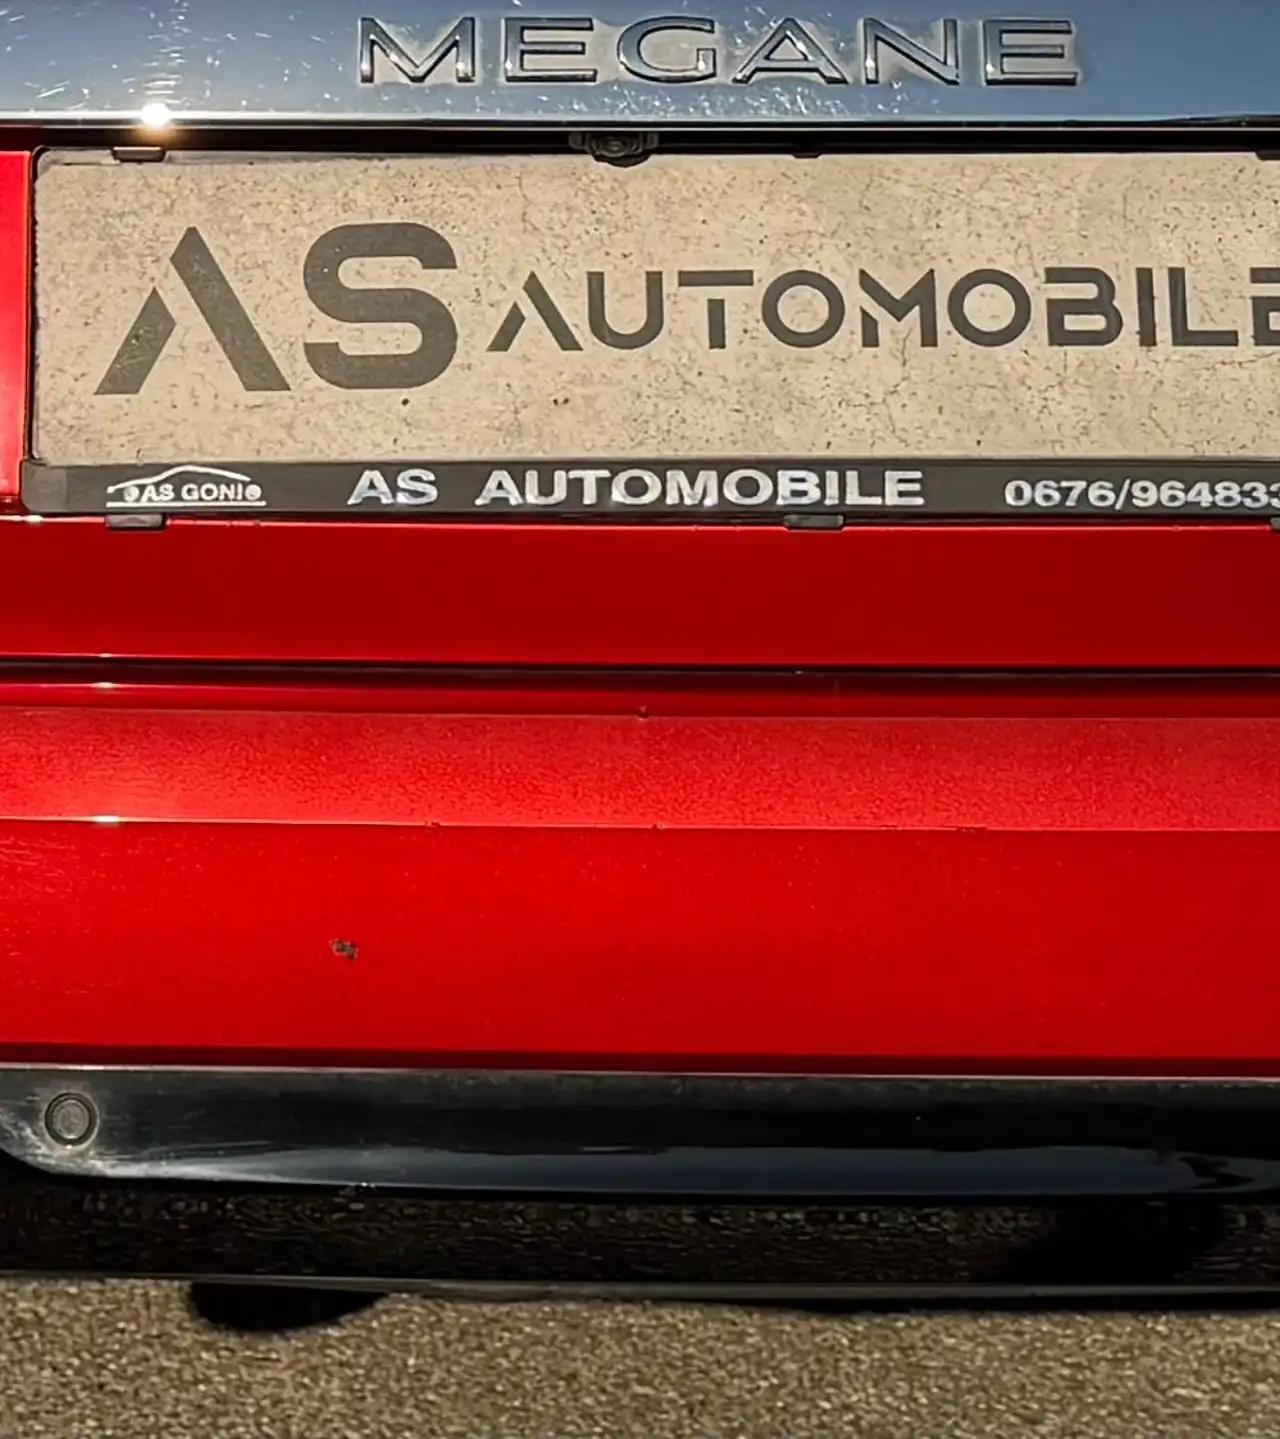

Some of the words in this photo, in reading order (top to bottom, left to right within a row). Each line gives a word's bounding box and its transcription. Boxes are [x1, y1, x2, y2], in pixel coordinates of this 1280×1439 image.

[359, 16, 1078, 86] MEGANE
[94, 222, 458, 394] AS
[140, 483, 175, 503] AS
[347, 469, 439, 506] AS
[474, 468, 926, 507] AUTOMOBILE
